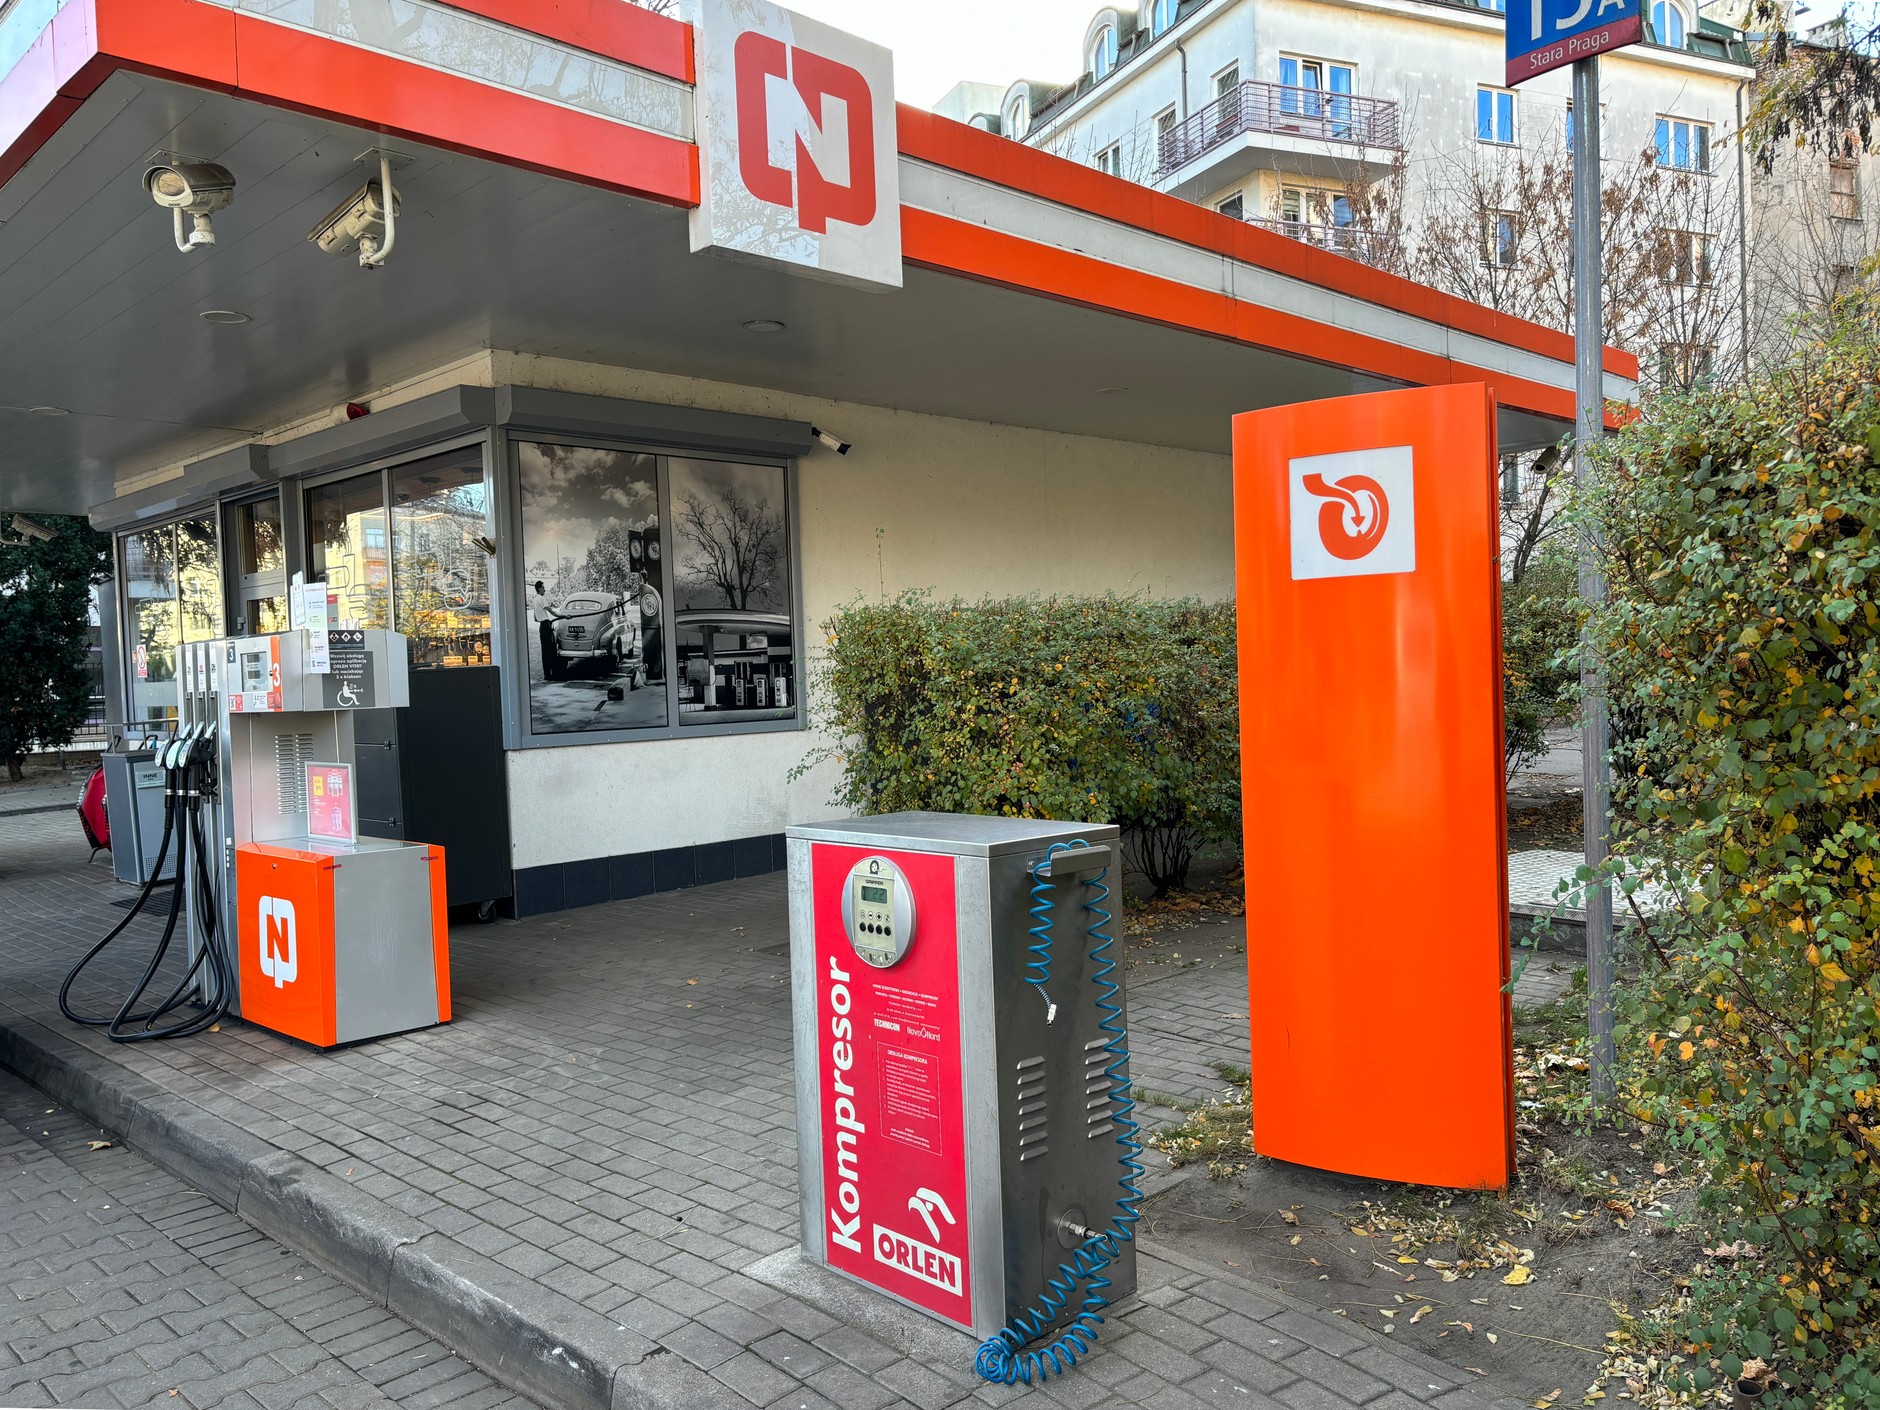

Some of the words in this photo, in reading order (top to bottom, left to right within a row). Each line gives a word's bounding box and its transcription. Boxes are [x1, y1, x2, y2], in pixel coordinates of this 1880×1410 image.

[1530, 47, 1563, 69] Stara
[1568, 31, 1609, 55] Praga
[229, 649, 234, 661] 3
[273, 662, 281, 687] 3
[874, 1018, 901, 1032] TECHNICON
[829, 955, 866, 1254] Kompresor
[878, 1232, 956, 1288] ORLEN
